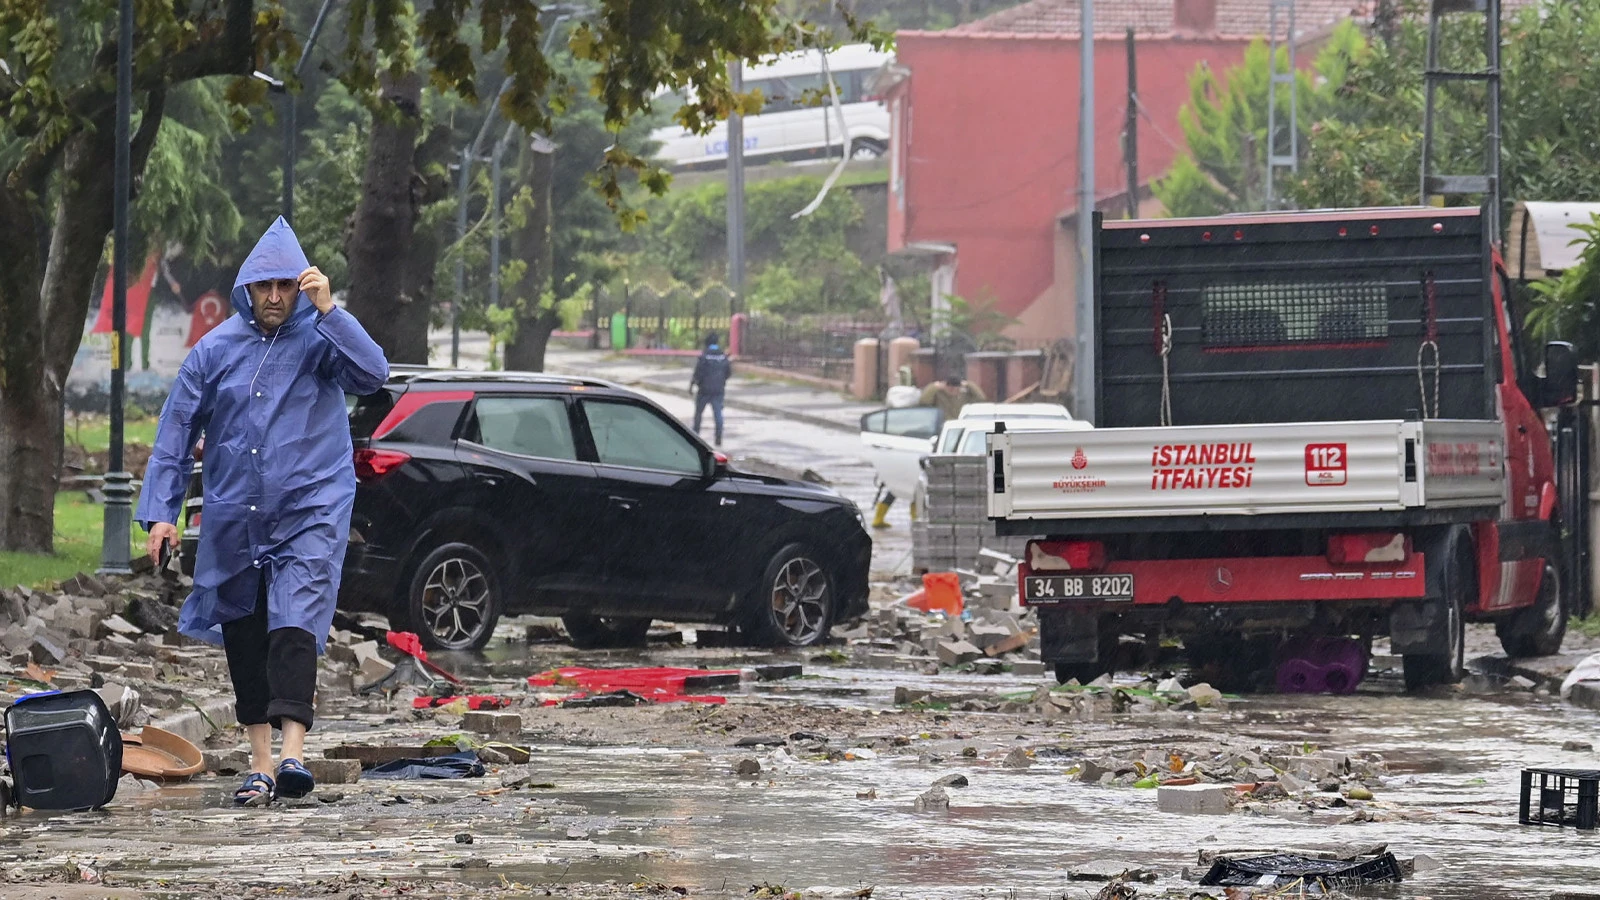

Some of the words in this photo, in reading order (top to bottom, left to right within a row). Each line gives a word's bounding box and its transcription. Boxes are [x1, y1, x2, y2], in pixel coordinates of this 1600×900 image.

[1311, 447, 1342, 468] 112
[1035, 579, 1055, 597] 34
[1064, 578, 1083, 596] BB
[1092, 577, 1131, 596] 8202
